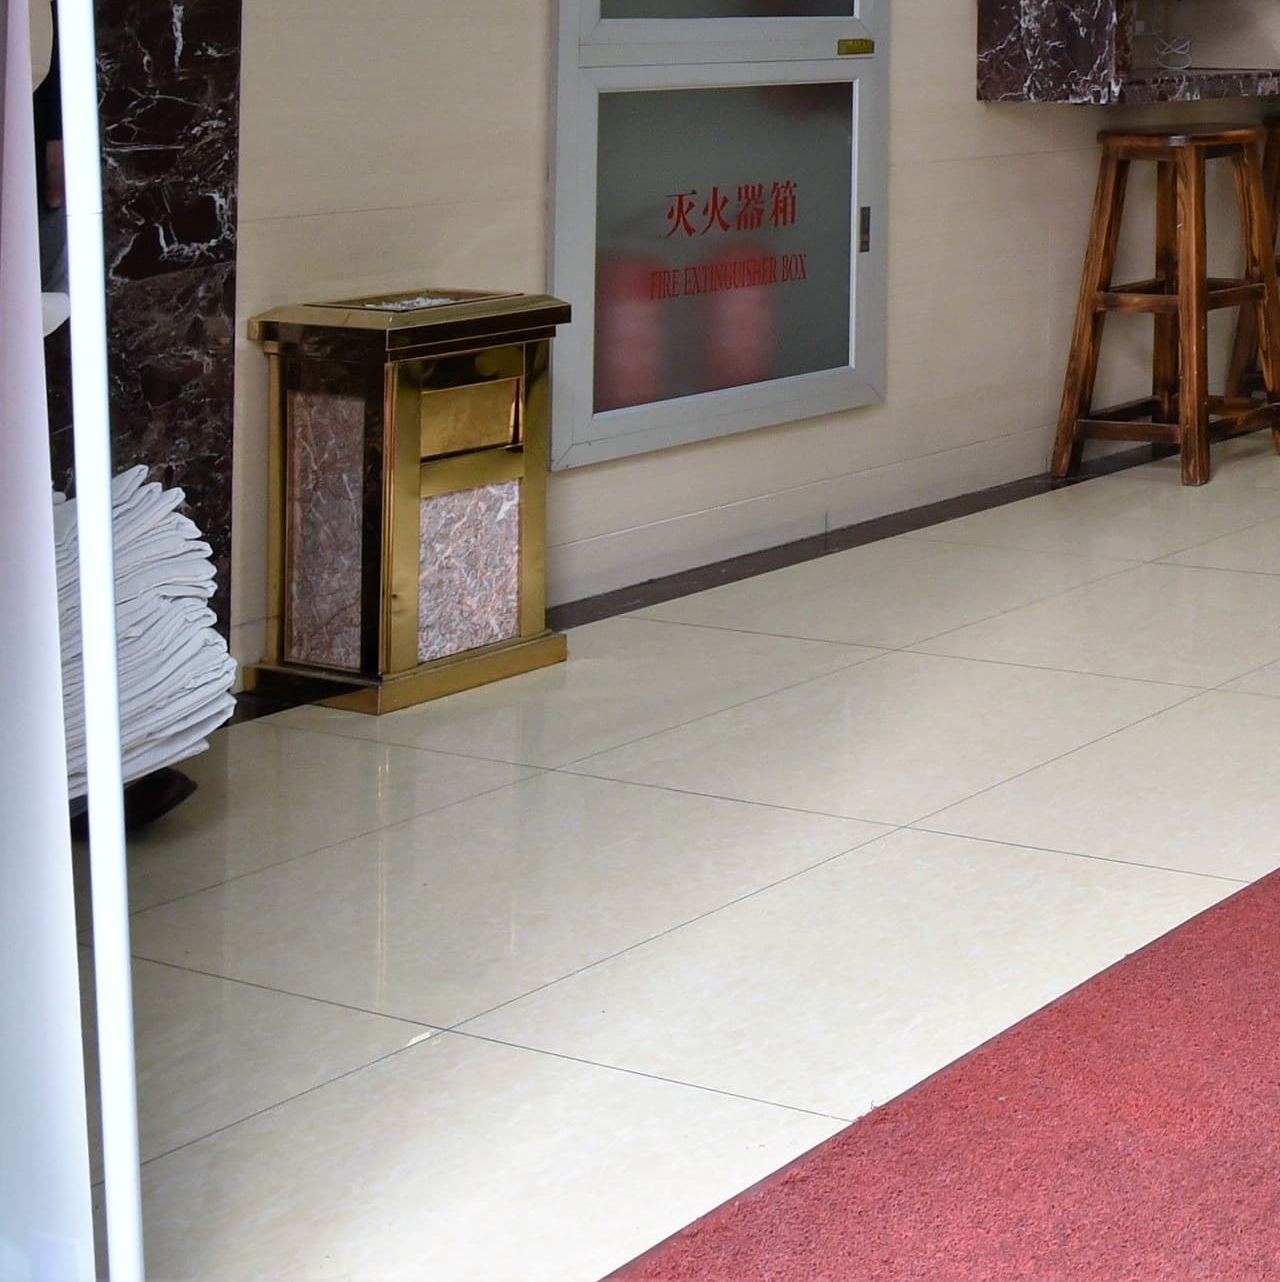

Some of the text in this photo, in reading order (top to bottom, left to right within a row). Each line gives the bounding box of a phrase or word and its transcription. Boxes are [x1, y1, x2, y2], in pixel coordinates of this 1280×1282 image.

[664, 180, 798, 239] 灭火器箱
[650, 253, 808, 301] FIRE EXTINGUISHER BOX
